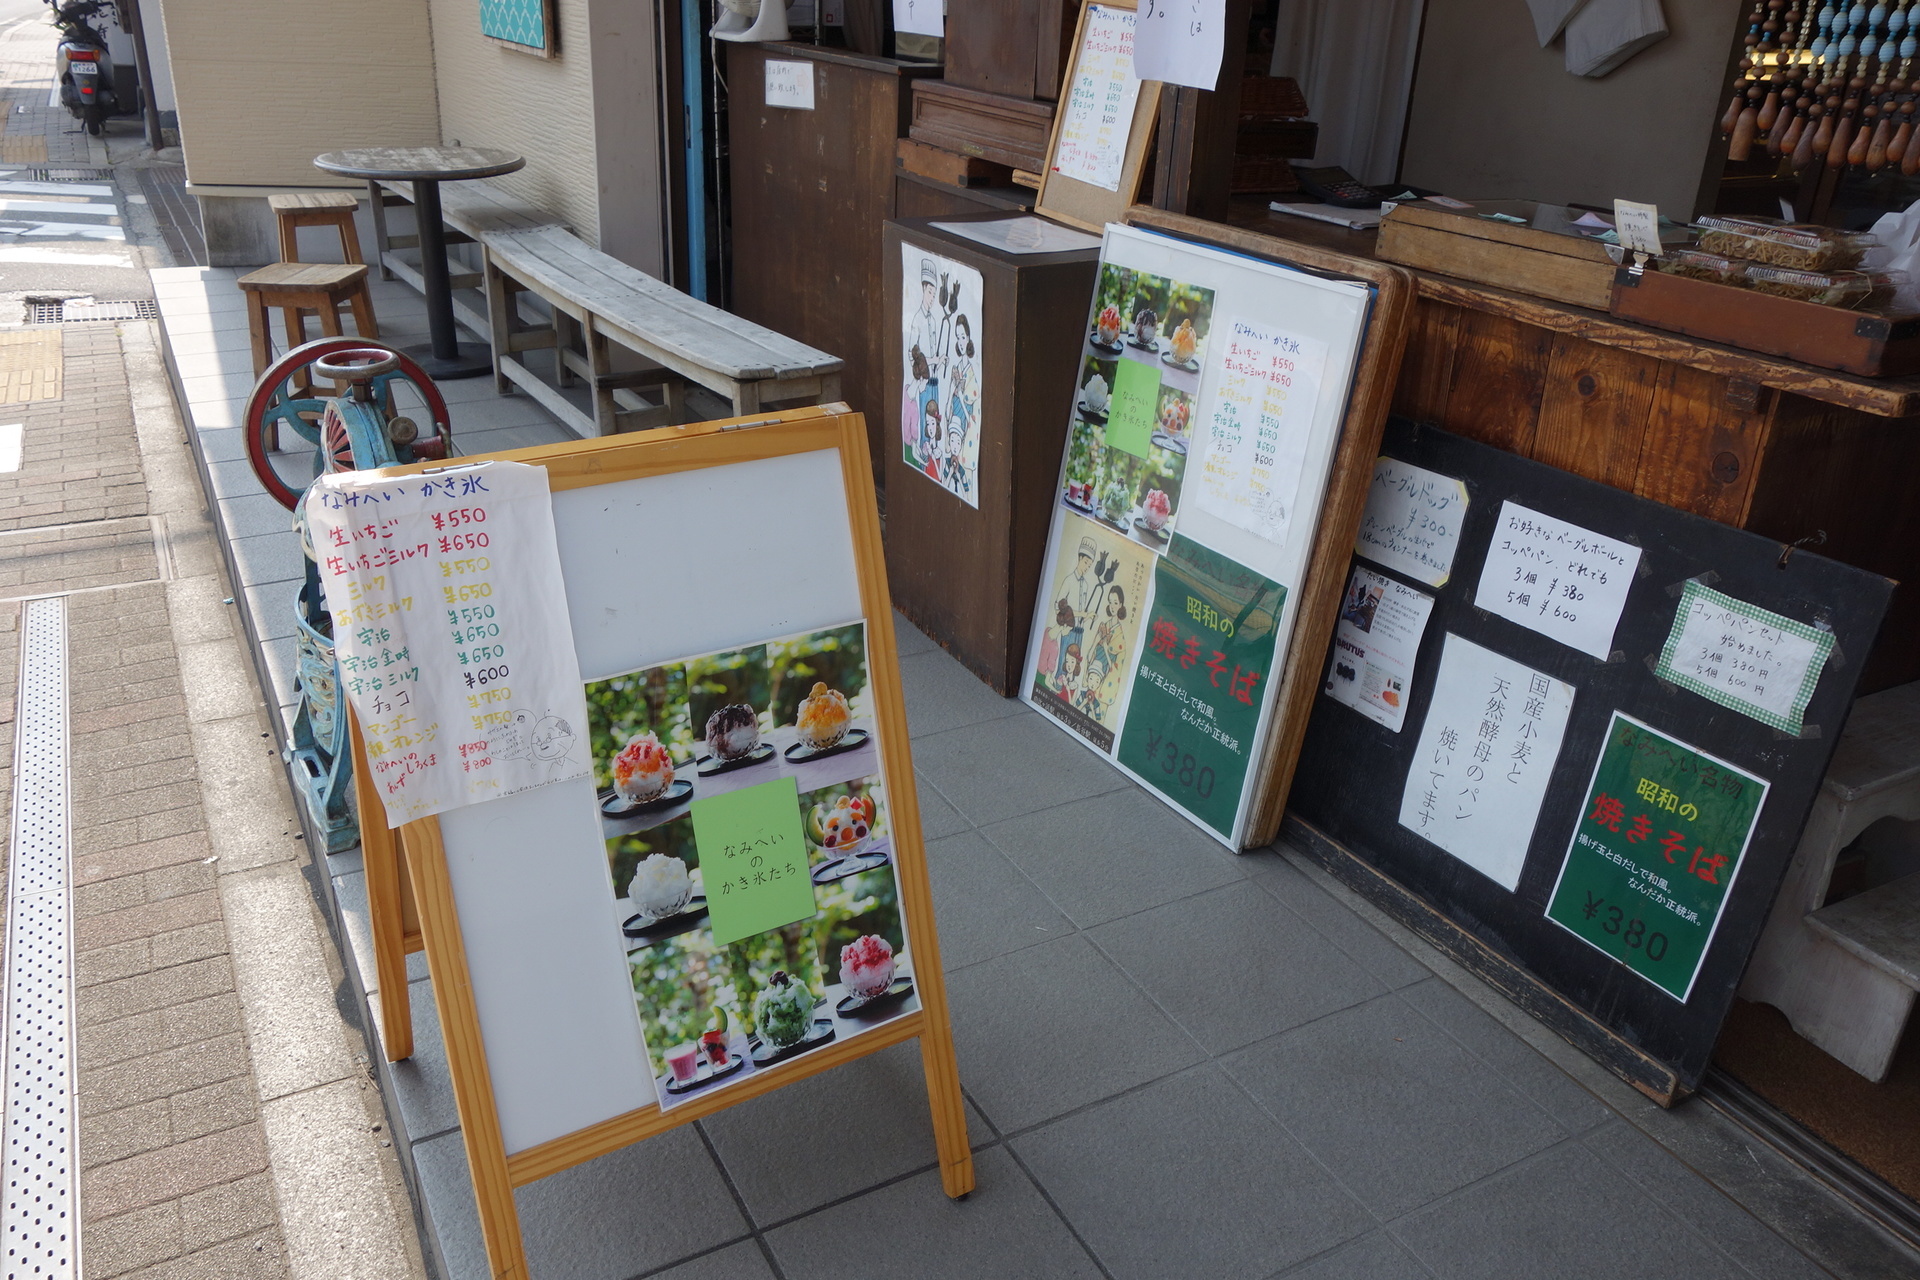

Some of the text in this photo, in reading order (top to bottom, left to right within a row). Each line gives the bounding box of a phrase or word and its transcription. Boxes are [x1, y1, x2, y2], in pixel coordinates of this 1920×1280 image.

[1122, 15, 1136, 27] かき
[1119, 45, 1134, 56] ¥650
[1109, 82, 1123, 92] ¥550
[1102, 115, 1116, 124] ¥600
[1234, 322, 1301, 354] なみへい かき氷
[1224, 357, 1292, 387] 生いちごミルク ¥650
[1230, 343, 1295, 371] 生いちご ¥550
[1123, 391, 1148, 406] なみへい
[1227, 375, 1287, 400] ミルク ¥550
[1115, 410, 1147, 429] かき氷たち
[1130, 405, 1136, 413] の
[1223, 401, 1280, 429] 宇治 ¥550
[1262, 400, 1283, 416] ¥650
[1211, 426, 1276, 454] 宇治ミルク ¥650
[1214, 413, 1278, 441] 宇治金時 ¥650
[1217, 440, 1274, 467] チョコ ¥600
[321, 474, 489, 510] なみへい かき氷
[1375, 468, 1459, 510] ベーグルドッグ
[329, 507, 486, 547] 生いちご ¥550
[326, 532, 489, 576] 生いちごミルク ¥650
[347, 556, 490, 600] ミルク ¥550
[1366, 572, 1420, 600] たい焼き なみへい
[1514, 566, 1538, 586] 3個
[1567, 559, 1609, 585] どれでも
[336, 582, 492, 627] あずきミルク ¥650
[1507, 590, 1531, 608] 5個
[356, 604, 495, 646] 宇治 ¥550
[1187, 594, 1235, 639] 昭和の
[1692, 602, 1786, 646] コッペパンセット
[341, 623, 500, 673] 宇治金時 ¥650
[1149, 615, 1260, 706] 焼きそば
[1336, 638, 1365, 658] BRUTUS
[1700, 647, 1723, 664] 3個
[1719, 633, 1782, 667] 始めました。
[348, 644, 504, 695] 宇治ミルク ¥650
[1695, 664, 1718, 679] 5個
[371, 665, 509, 714] チョコ ¥600
[1140, 664, 1218, 722] 揚げ玉と白だしで和風。
[367, 687, 511, 736] マンゴー ¥750
[471, 710, 512, 730] ¥750
[1180, 706, 1242, 756] なんだか正統派。
[1506, 672, 1551, 785] 国産小麦と
[375, 752, 418, 773] なみへいの
[406, 753, 437, 774] しろくま
[458, 740, 488, 759] ¥850
[1146, 728, 1216, 800] ¥380
[1455, 674, 1512, 821] 天然酵母のパン
[1619, 726, 1744, 800] なみへい名物
[463, 757, 492, 773] ¥800
[1418, 725, 1459, 839] 焼いてます。
[1636, 777, 1699, 822] 昭和の
[724, 833, 784, 859] なみへい
[1588, 792, 1729, 885] 焼きそば
[750, 855, 763, 868] の
[1577, 832, 1673, 894] 揚げ玉と白だしで和風。
[722, 862, 796, 895] かき氷たち
[1627, 876, 1702, 927] なんだか正統派。
[1582, 890, 1669, 962] ¥380
